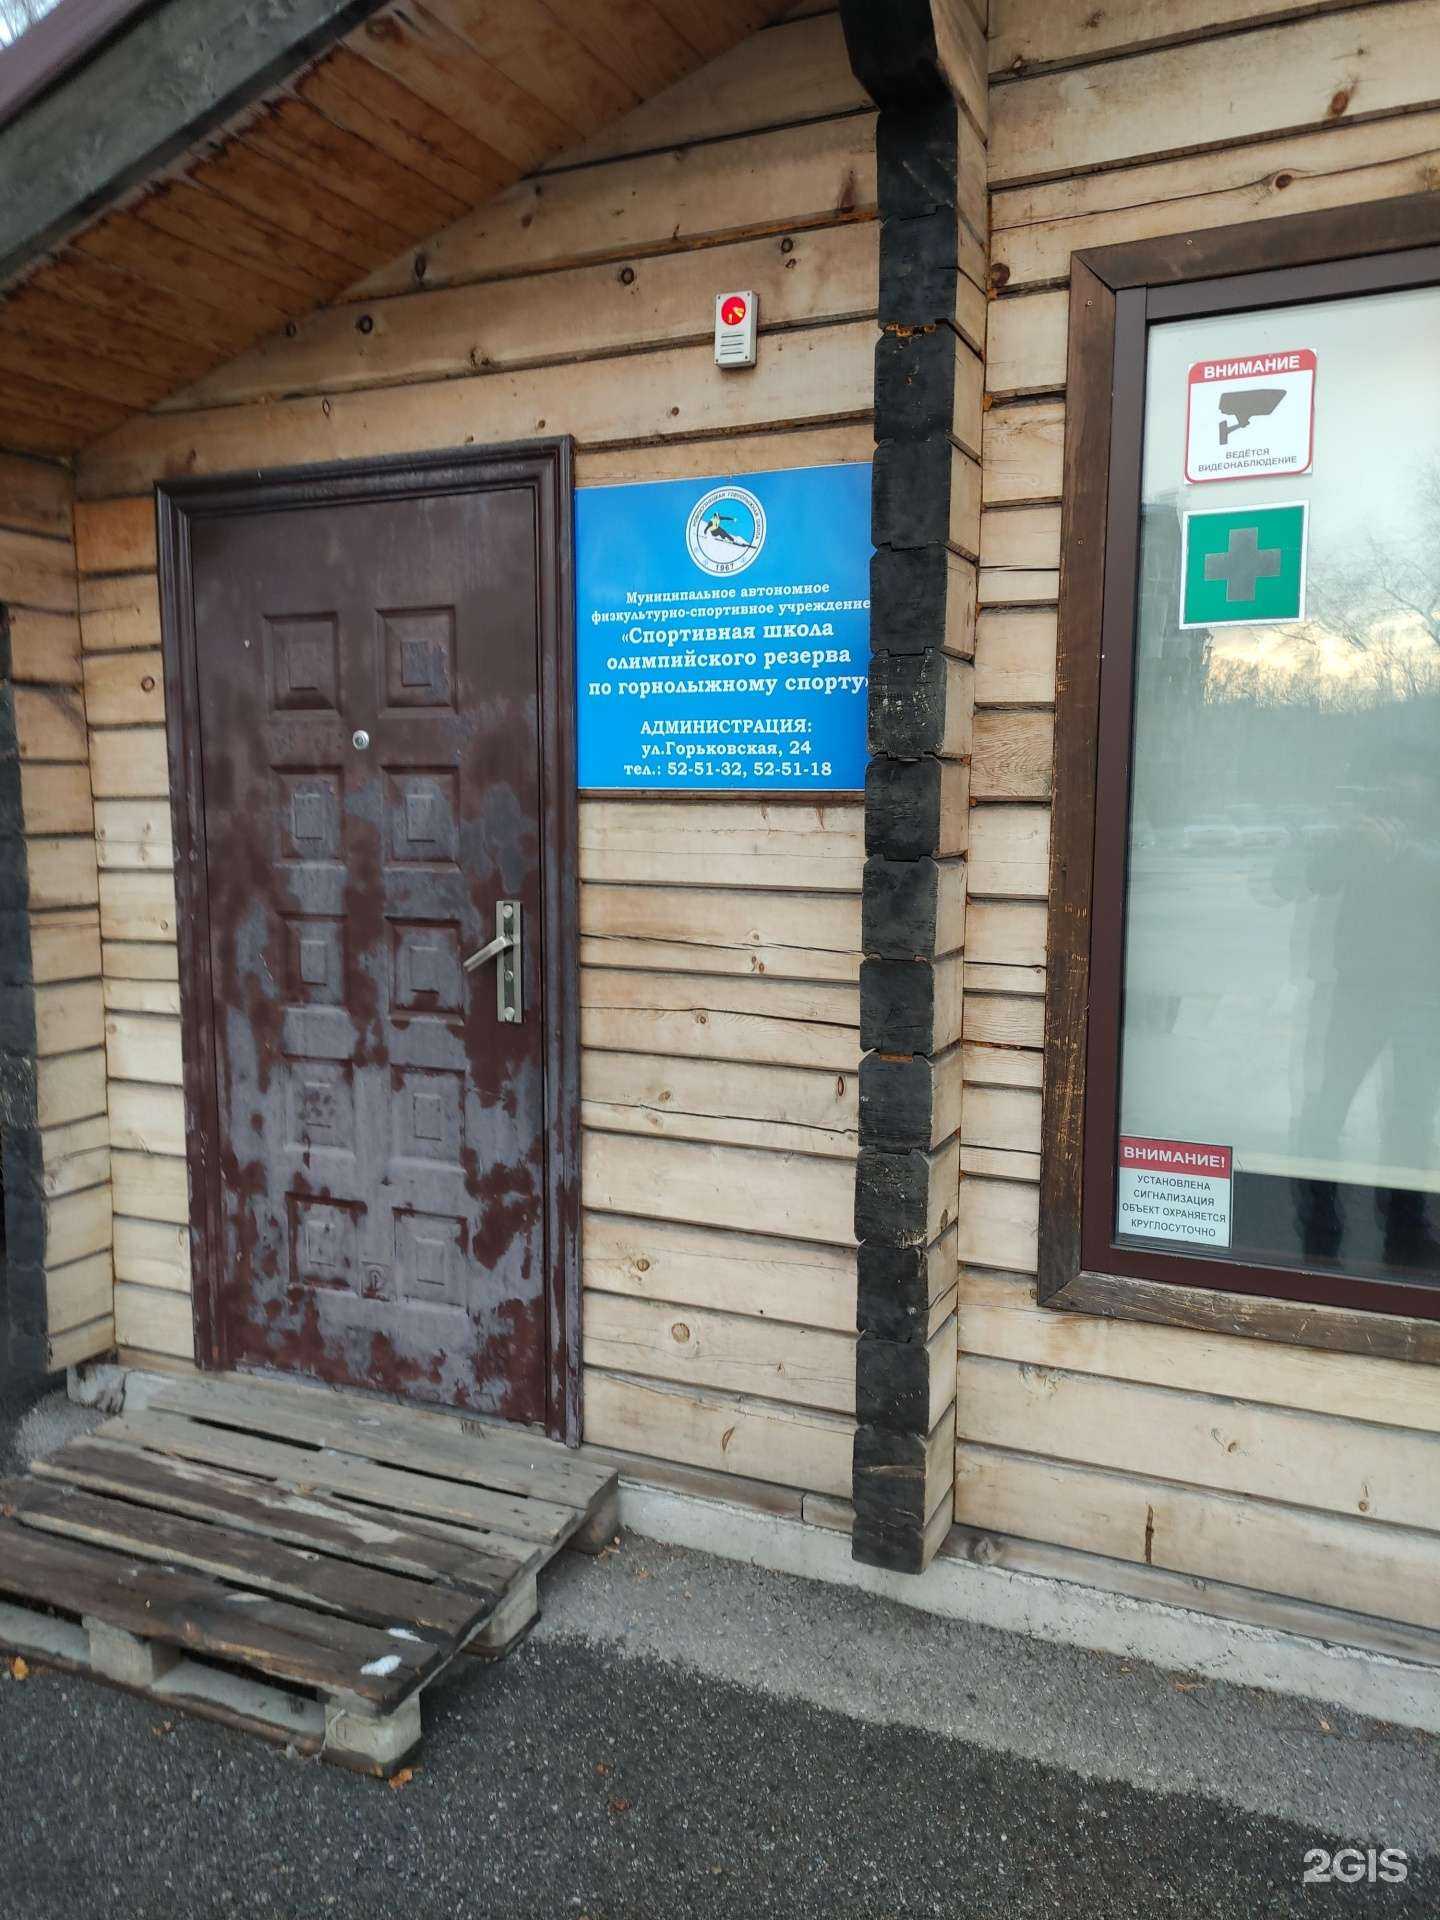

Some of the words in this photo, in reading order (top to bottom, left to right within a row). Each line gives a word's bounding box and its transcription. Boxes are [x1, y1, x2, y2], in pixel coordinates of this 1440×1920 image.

[1203, 355, 1301, 379] ВНИМАНИЕ
[1198, 455, 1297, 472] ВИДЕОНАБЛЮДЕНИЕ
[626, 588, 736, 607] Муниципальное
[740, 583, 830, 598] автономное
[591, 603, 774, 625] физкультурно-спортивное
[778, 599, 871, 616] учреждение
[622, 626, 756, 647] «Спортивная
[763, 622, 835, 639] школа
[606, 649, 757, 671] олимпийского
[763, 649, 852, 670] резерва
[588, 682, 612, 696] по
[618, 678, 778, 699] горнолыжному
[640, 718, 813, 736] АДМИНИСТРАЦИЯ:
[641, 740, 783, 759] ул.Горьковская,
[789, 740, 812, 755] 24
[623, 764, 661, 776] тел.:
[667, 761, 748, 779] 52-51-32,
[753, 761, 832, 777] 52-51-18
[1123, 1146, 1225, 1168] ВНИМАНИЕ!
[1137, 1175, 1211, 1191] УСТАНОВЛЕНА
[1133, 1189, 1215, 1206] СИГНАЛИЗАЦИЯ
[1122, 1202, 1160, 1215] ОБЪЕКТ
[1162, 1207, 1226, 1223] ОХРАНЯЕТСЯ
[1131, 1219, 1216, 1237] КРУГЛОСУТОЧНО
